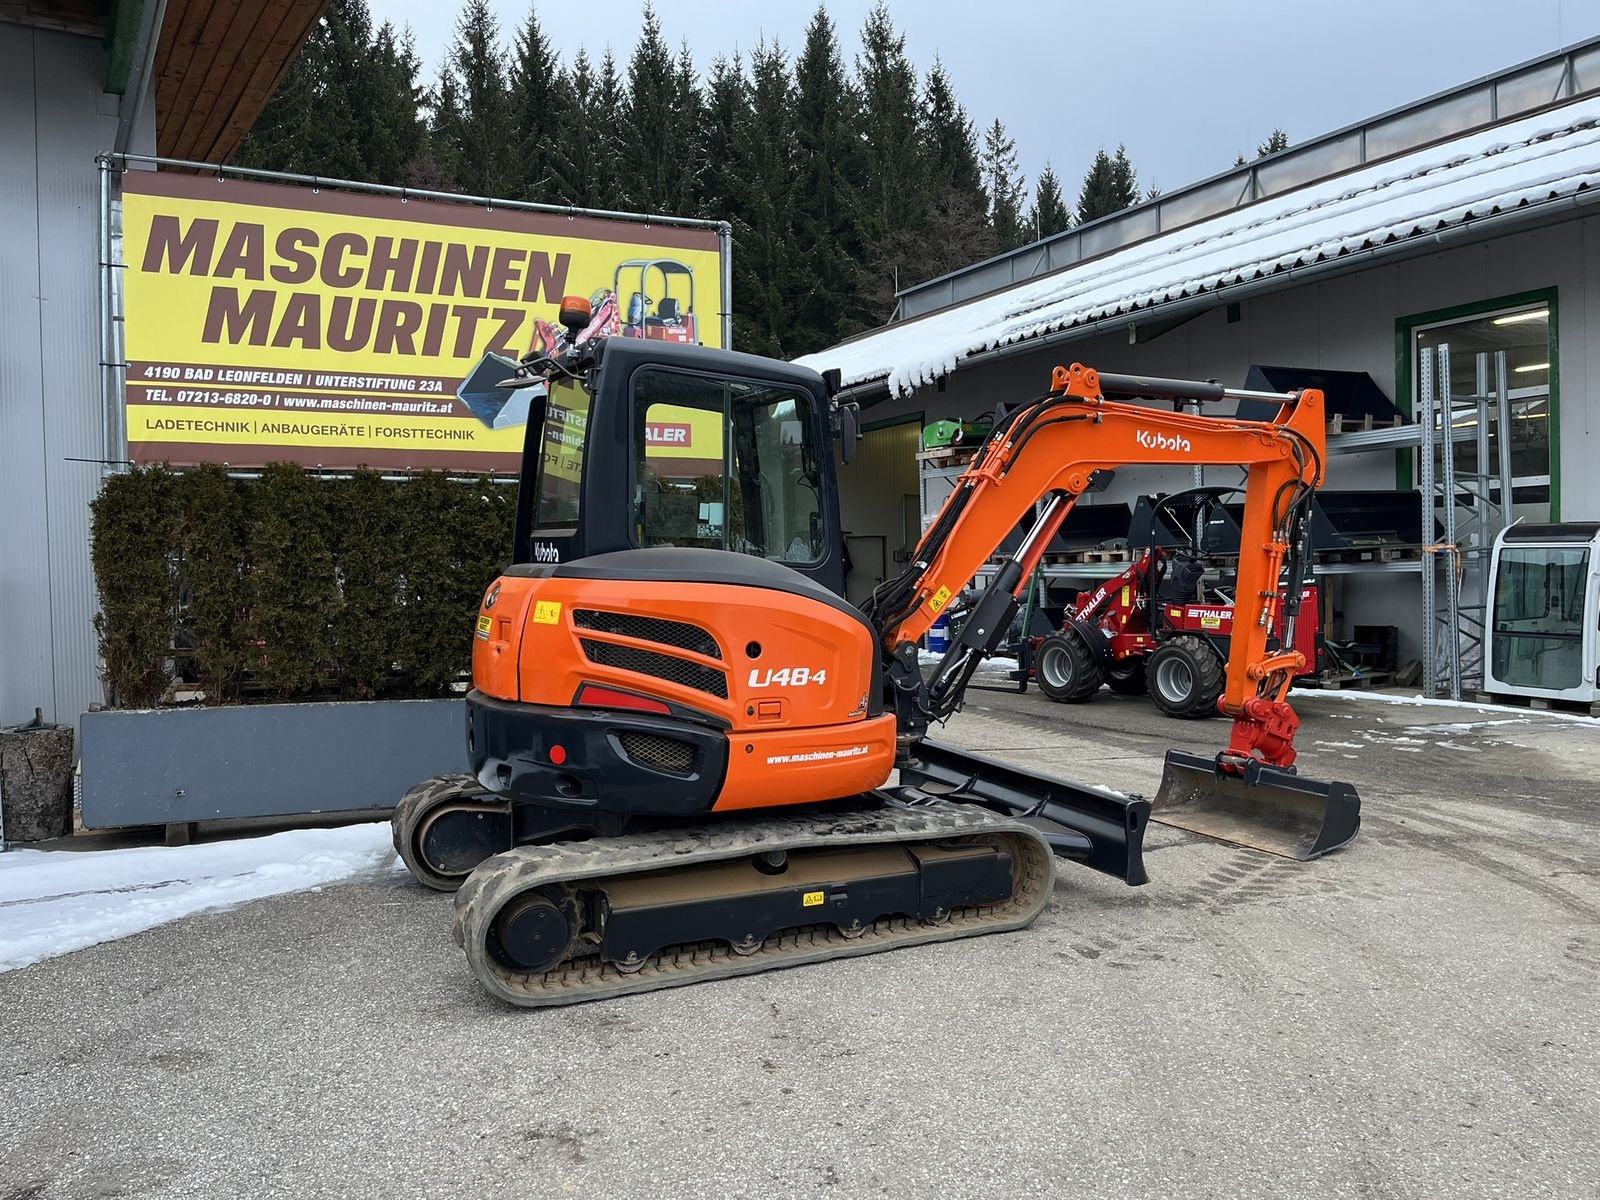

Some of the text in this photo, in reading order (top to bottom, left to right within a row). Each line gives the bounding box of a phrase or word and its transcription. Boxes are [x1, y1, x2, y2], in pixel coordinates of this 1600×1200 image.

[141, 215, 571, 304] MASCHINEN
[201, 286, 526, 361] MAURITZ
[144, 366, 443, 392] 4190 BAD LEONFELDEN UNTERSTIFTUNG 23A
[145, 389, 453, 414] TEL. 07213-6820-0 www.maschinen-mauritz.at
[146, 418, 475, 441] LADETECHNIK ANBAUGERÄTE FORSTTECHNIK
[645, 427, 687, 442] ALER
[1136, 429, 1191, 453] Kubota
[534, 542, 560, 563] Kubota
[1079, 587, 1107, 620] THALER
[1198, 609, 1233, 620] THALER
[747, 667, 827, 688] U48-4
[766, 745, 869, 765] www.maschinen-mauritz.at
